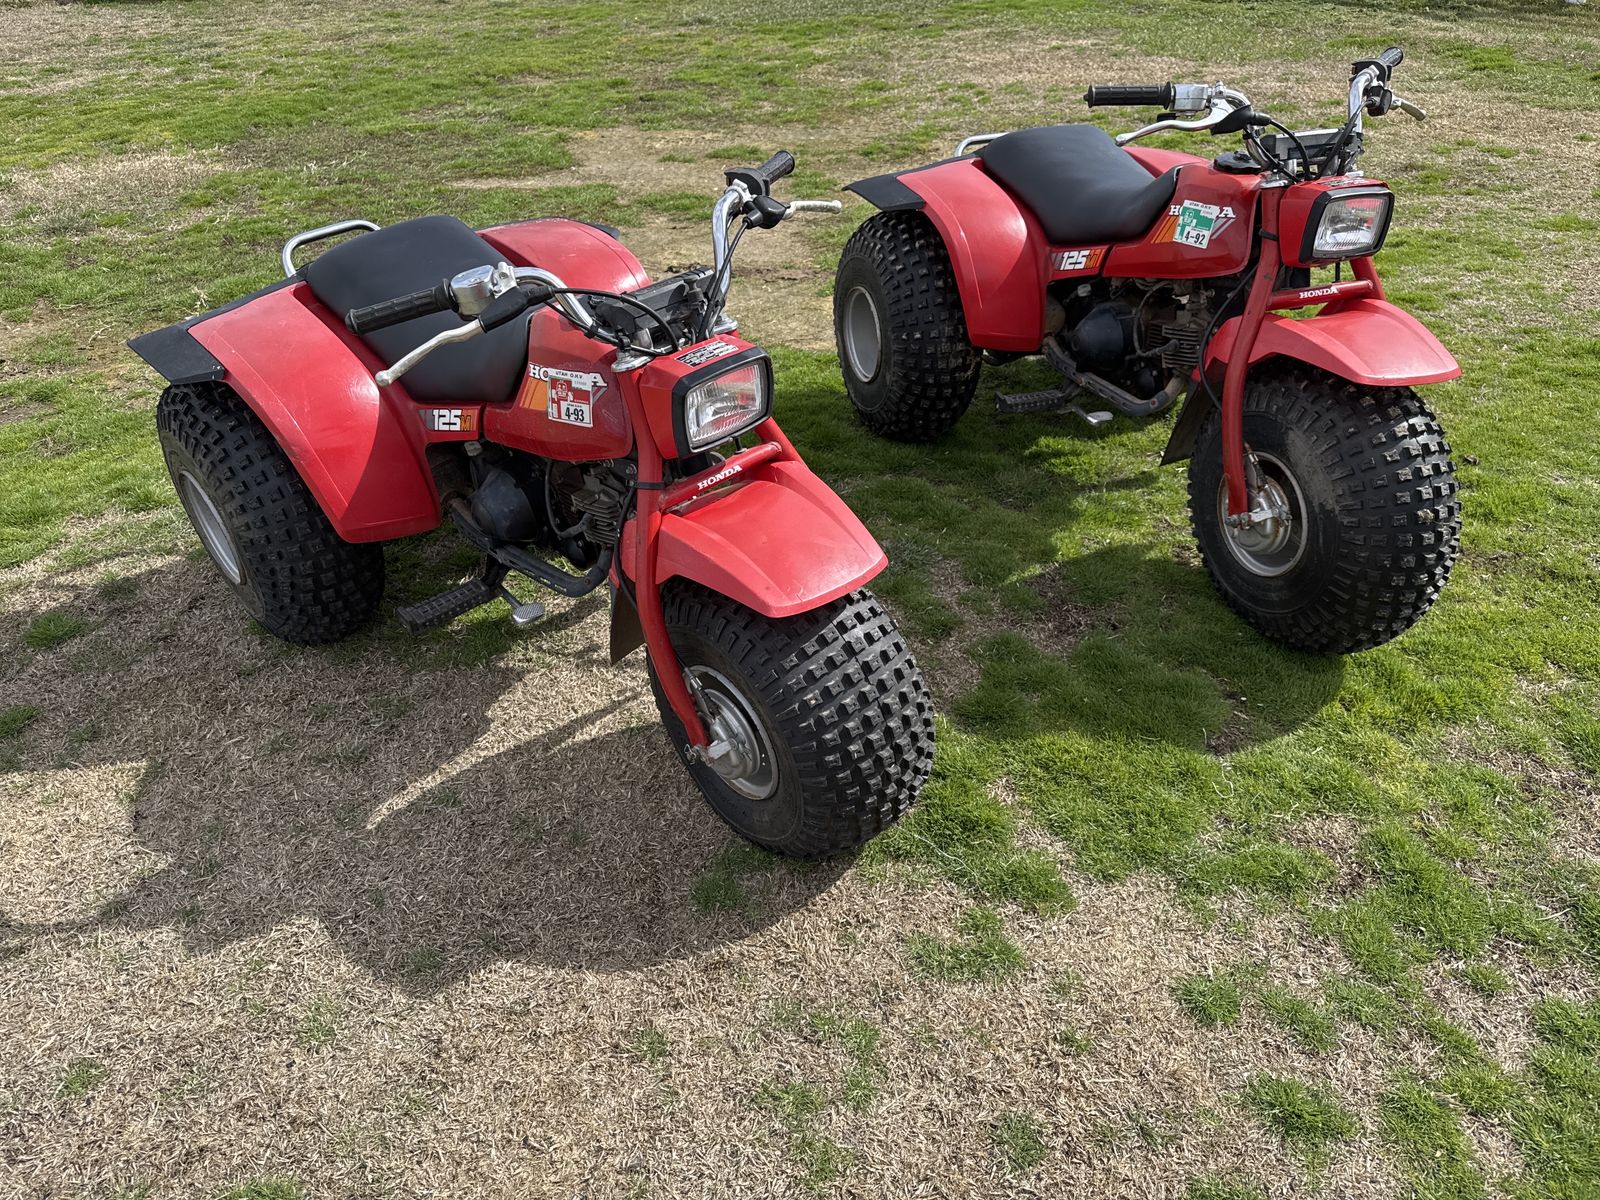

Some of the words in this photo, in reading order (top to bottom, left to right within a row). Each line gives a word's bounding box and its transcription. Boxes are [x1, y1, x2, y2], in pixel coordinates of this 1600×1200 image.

[1184, 231, 1206, 245] 4-92
[1299, 286, 1339, 299] HONDA
[529, 362, 608, 388] HOA
[565, 406, 585, 422] 4-93
[697, 464, 743, 491] HONDA
